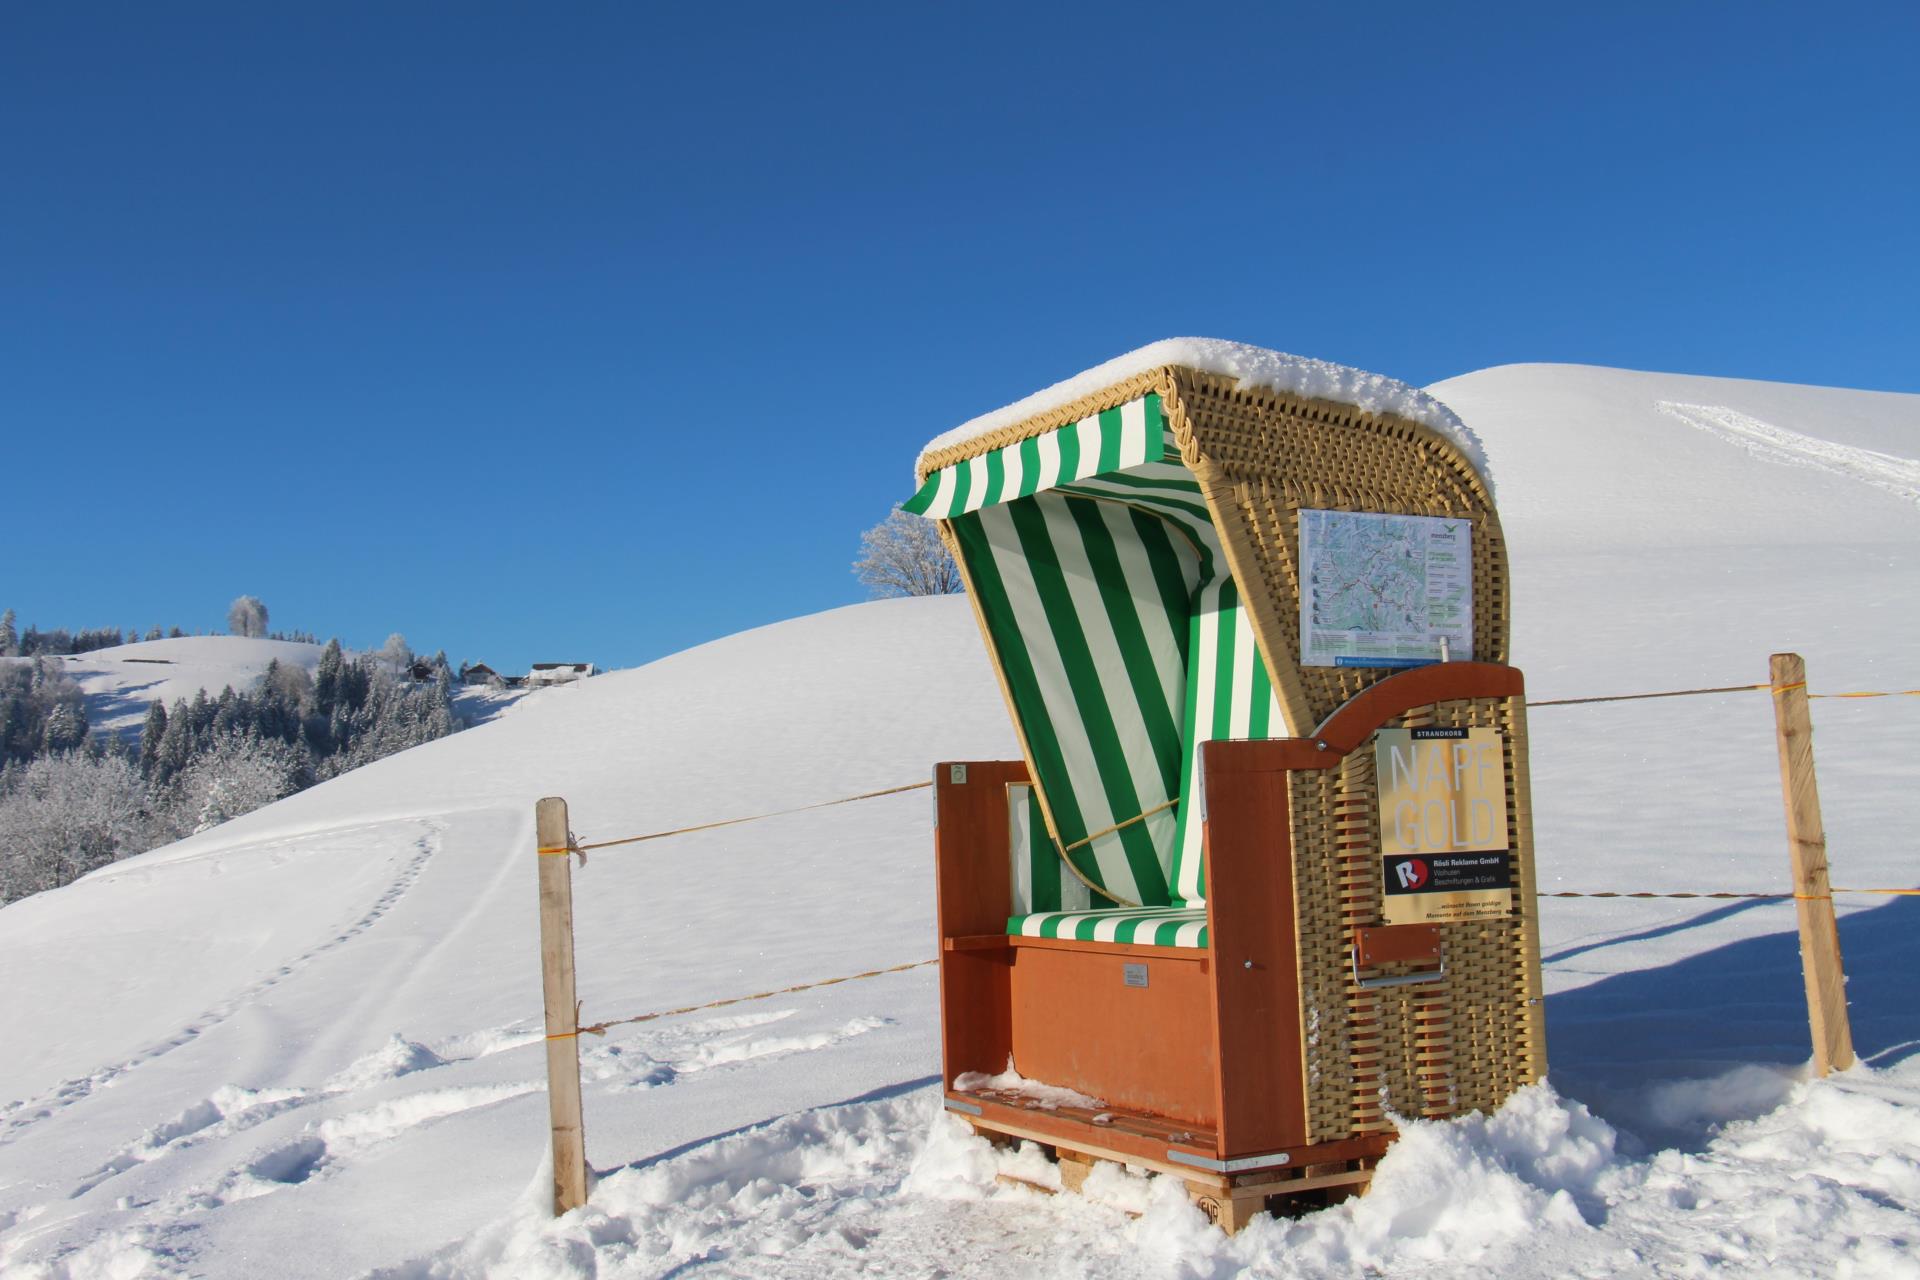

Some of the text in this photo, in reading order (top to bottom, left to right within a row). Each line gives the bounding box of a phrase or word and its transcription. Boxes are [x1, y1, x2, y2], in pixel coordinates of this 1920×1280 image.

[1390, 743, 1494, 793] NAPF
[1394, 798, 1496, 849] GOLD
[1433, 857, 1499, 867] Rösli Reklame GmbH
[1453, 910, 1462, 918] auf
[1463, 909, 1475, 917] dem
